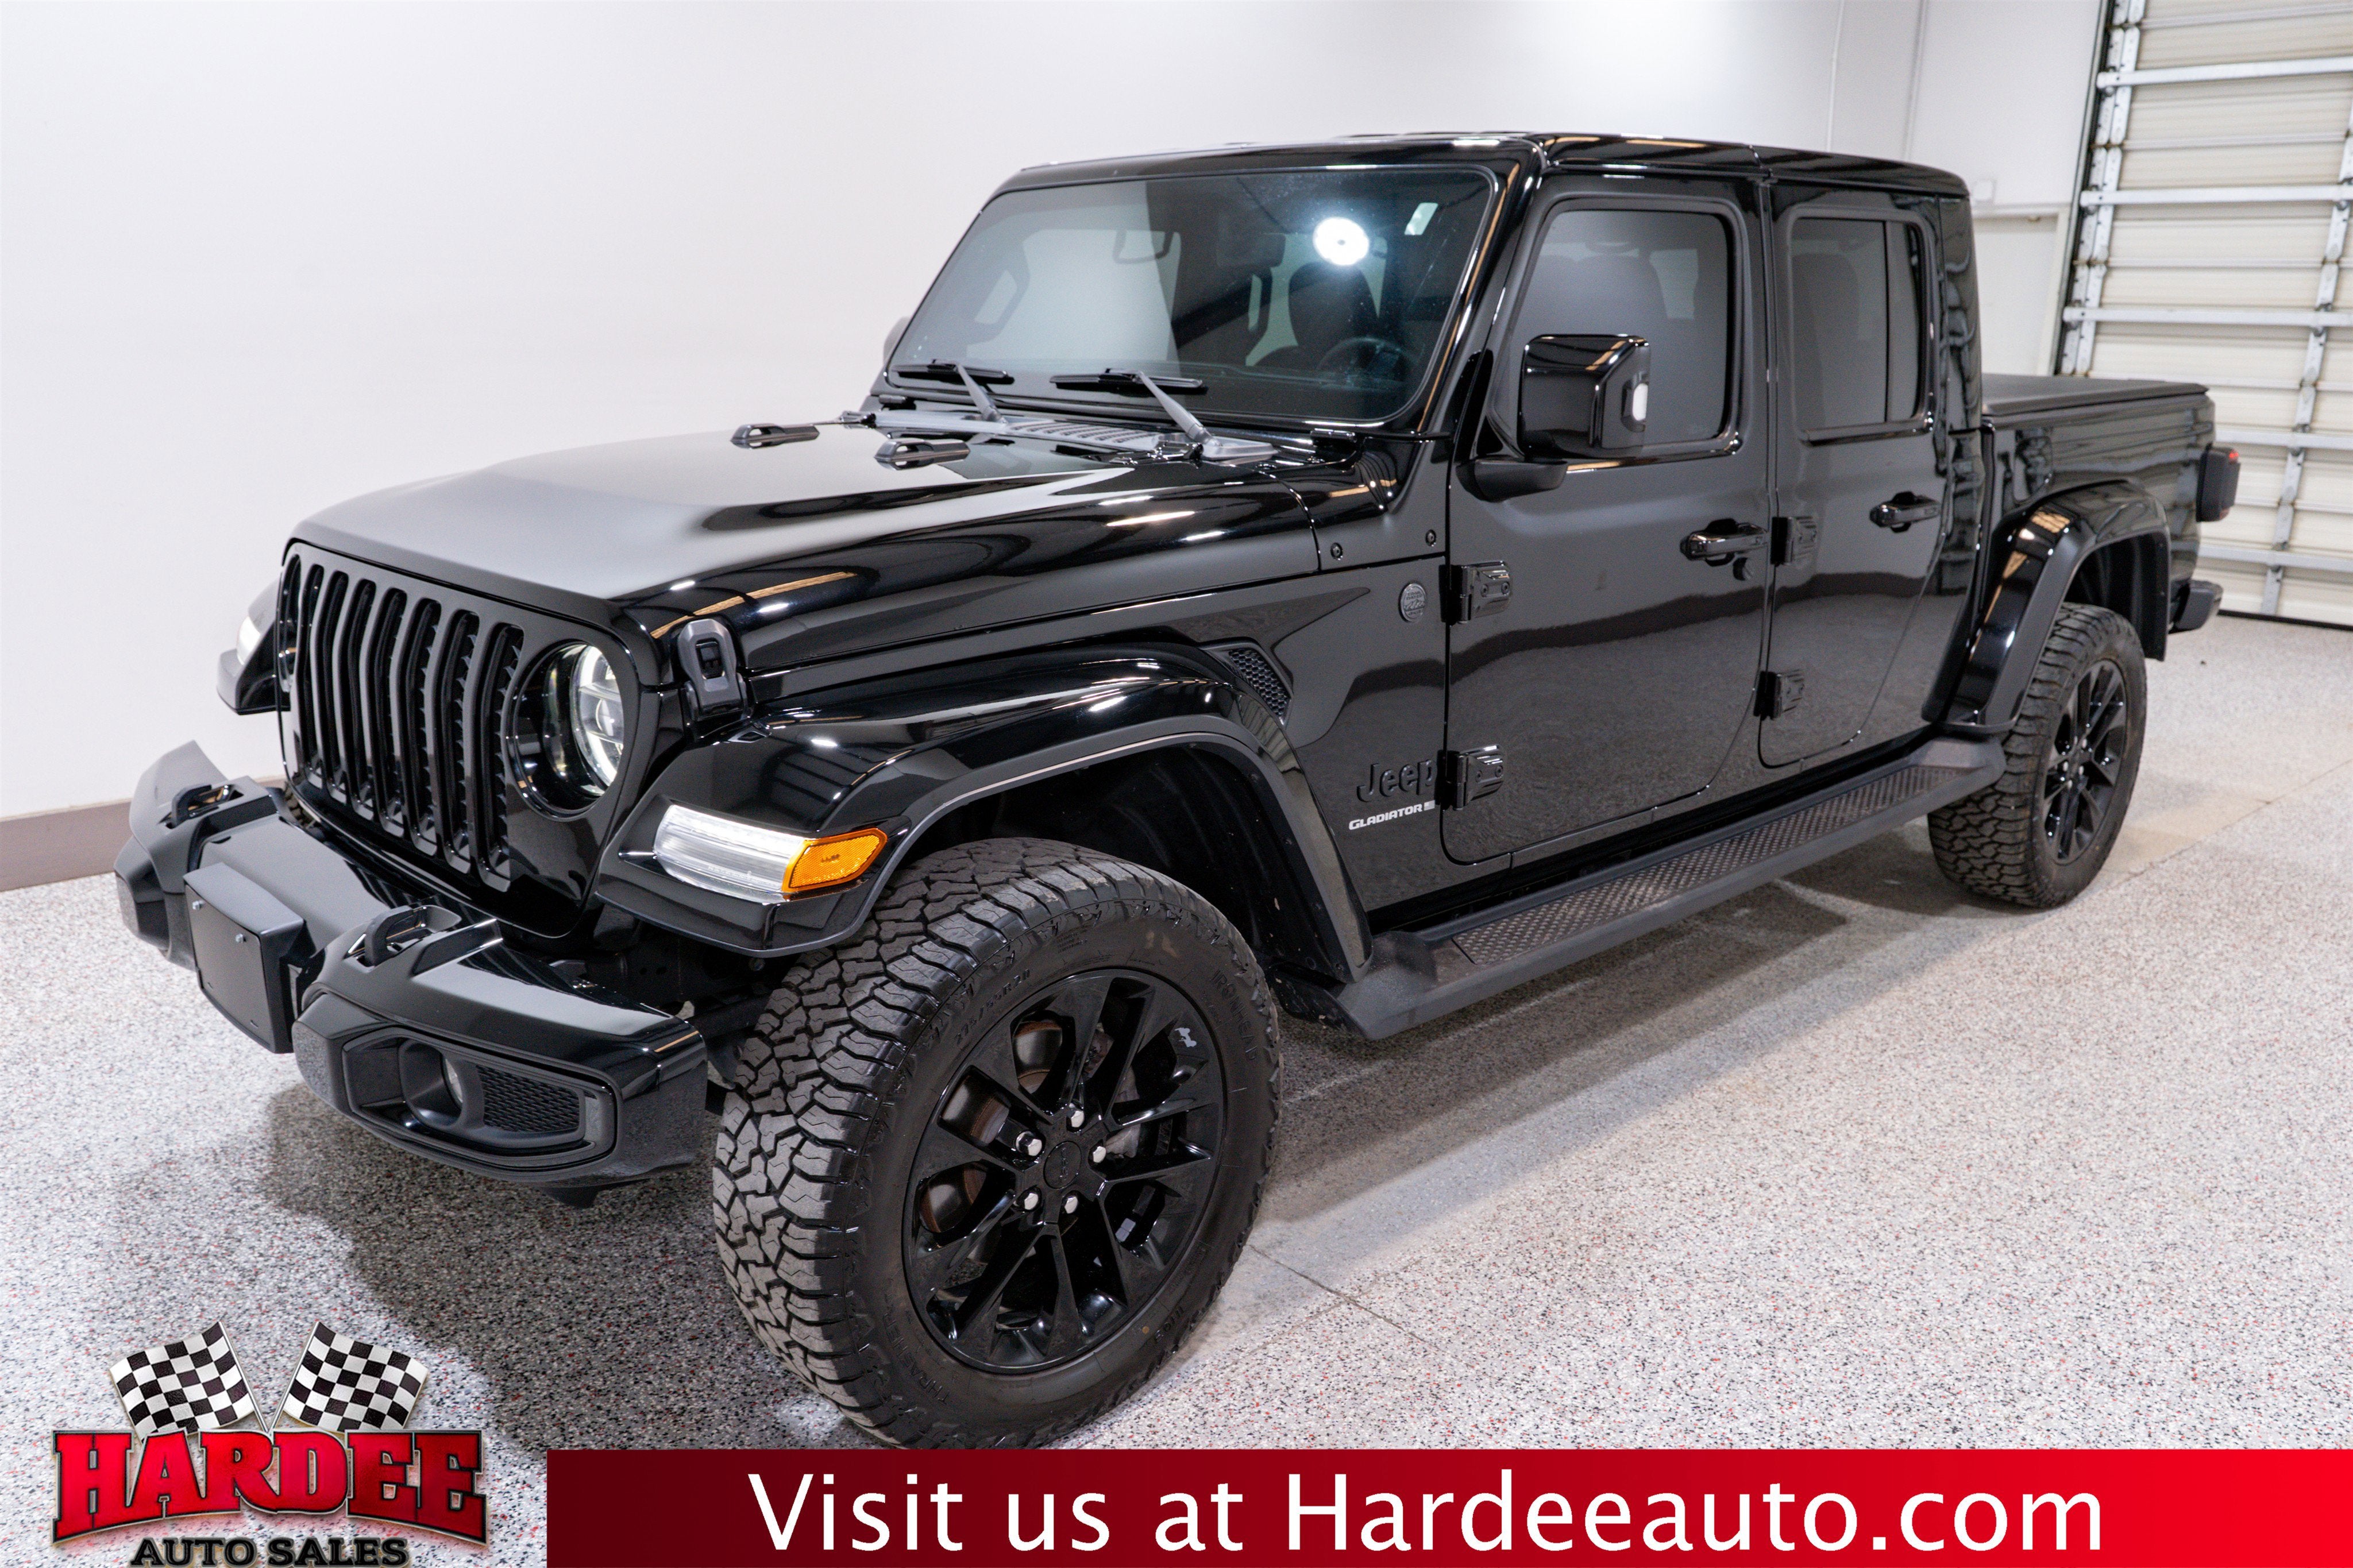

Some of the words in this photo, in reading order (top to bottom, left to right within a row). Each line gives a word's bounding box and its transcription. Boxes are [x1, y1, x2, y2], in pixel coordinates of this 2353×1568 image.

[1356, 759, 1437, 802] Jeep
[1349, 804, 1423, 830] GLADIATOR
[1209, 970, 1259, 1061] IRONHEAD
